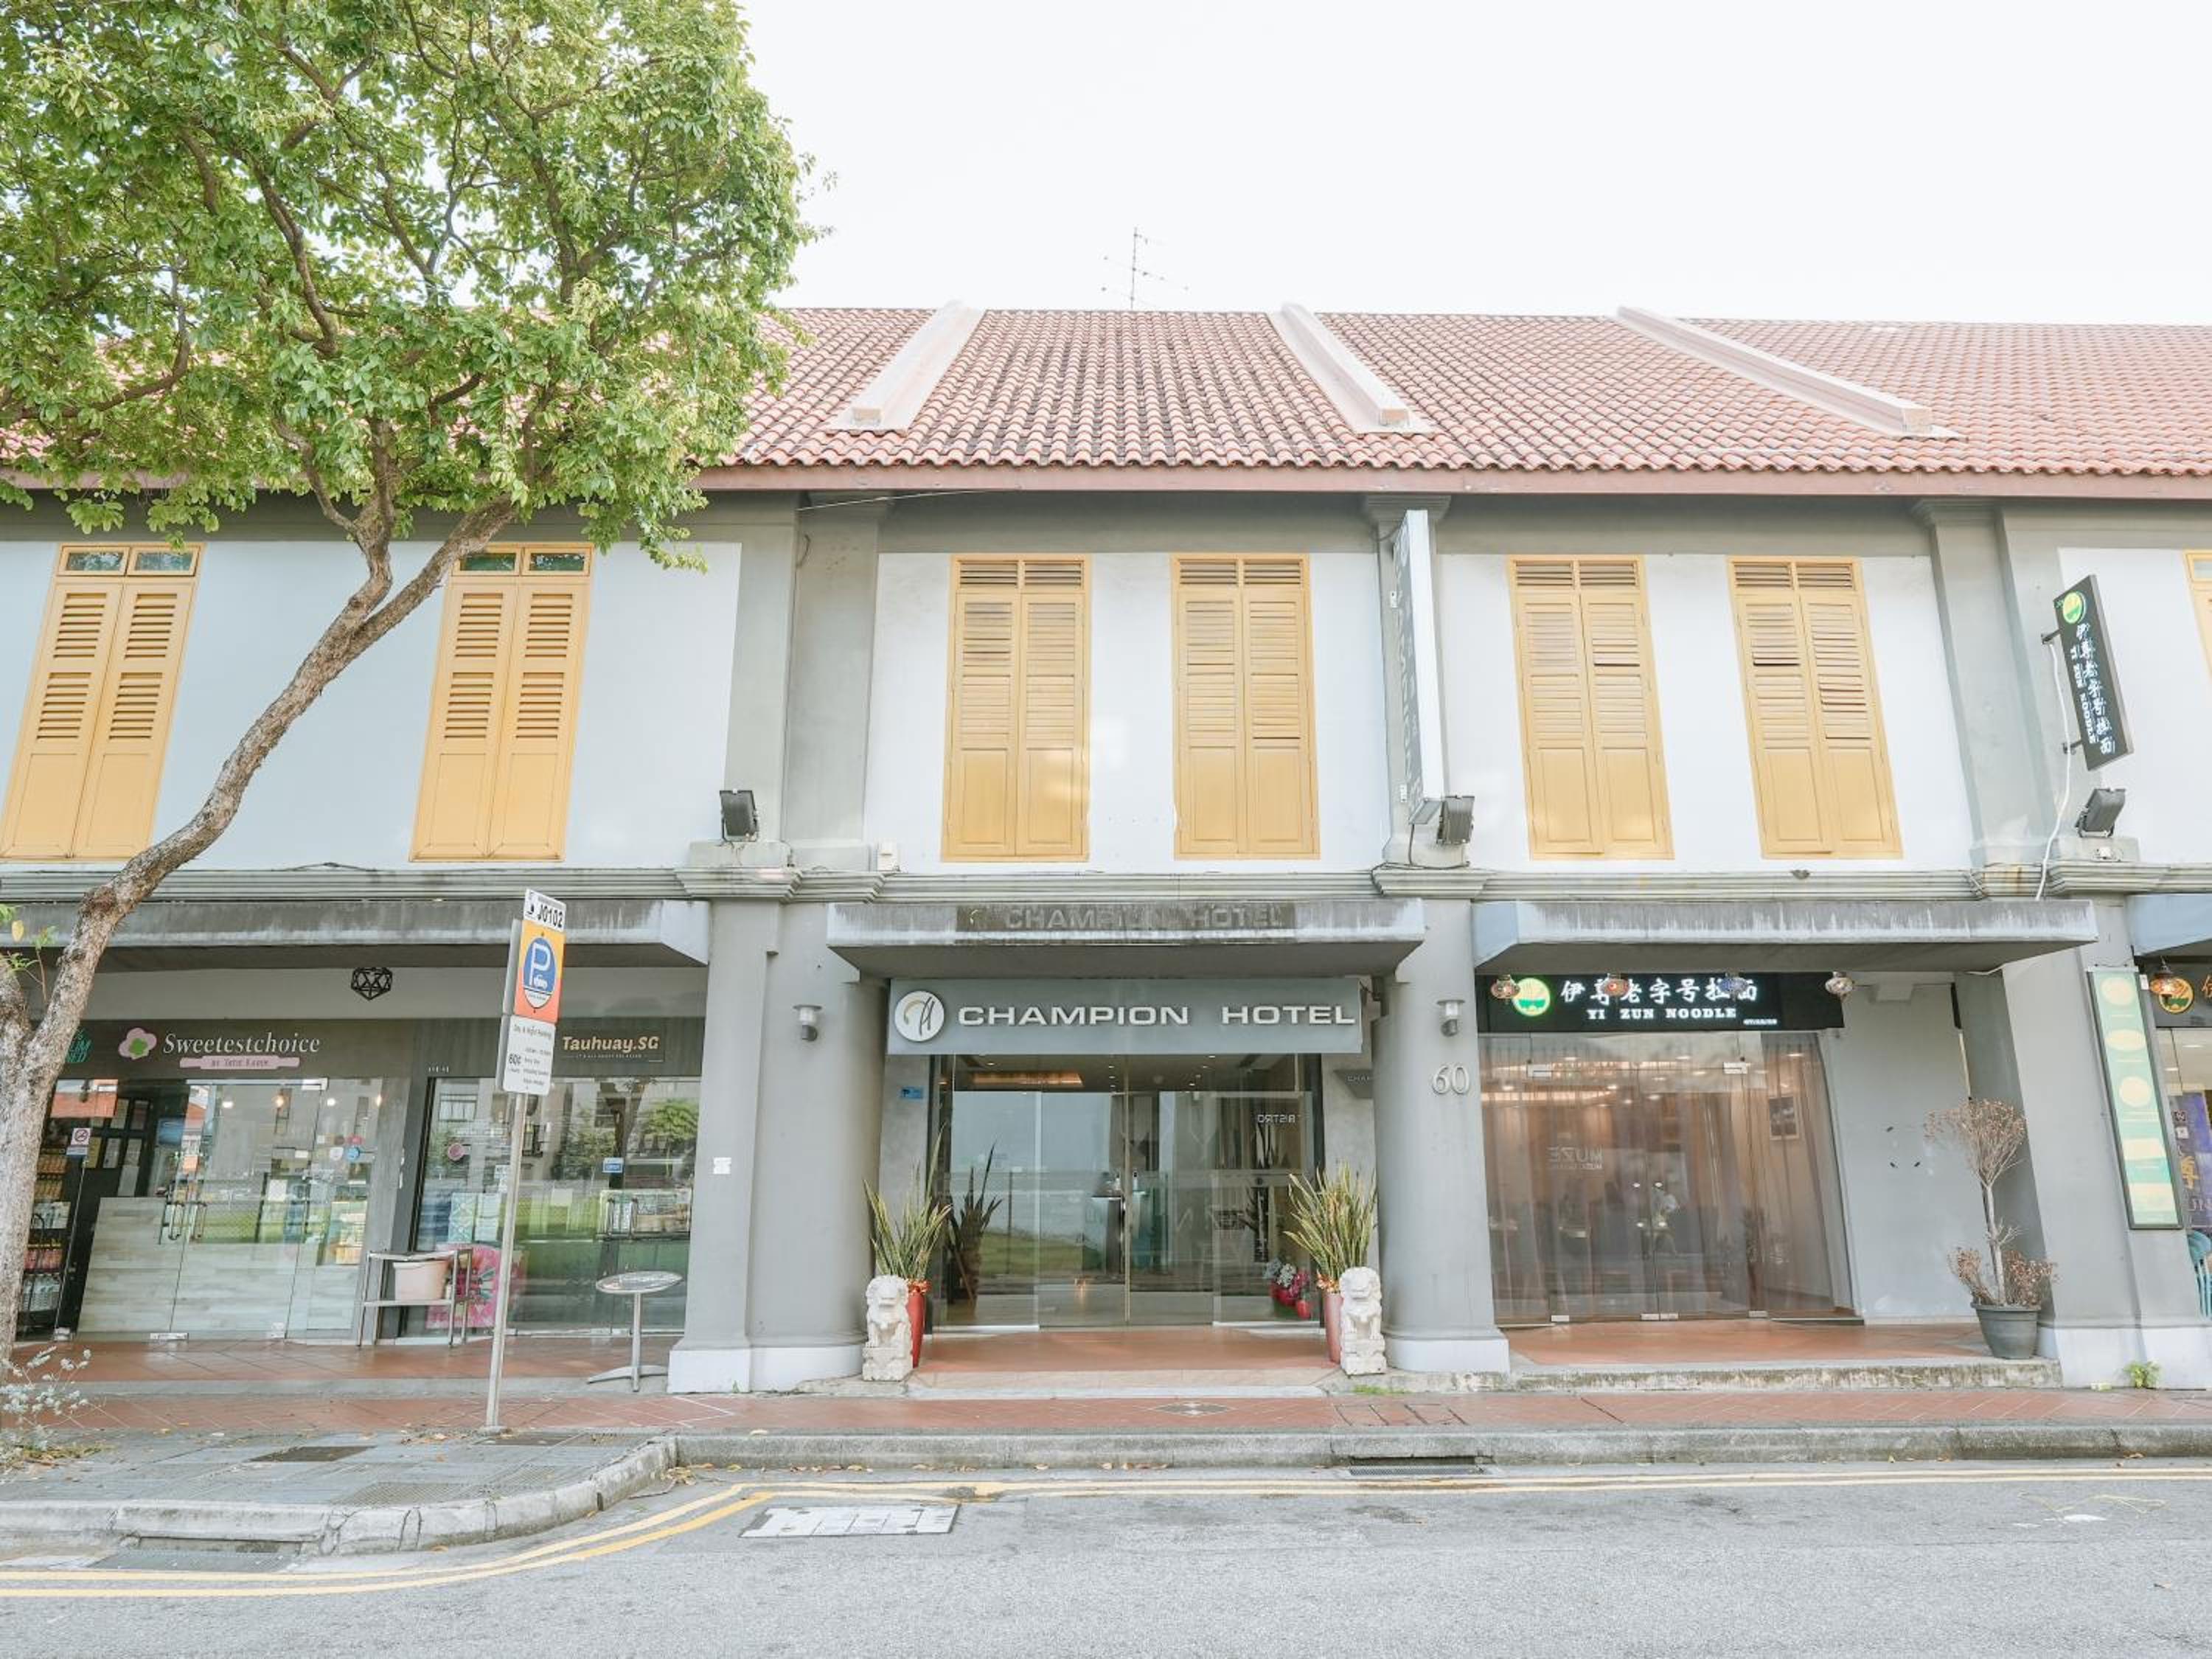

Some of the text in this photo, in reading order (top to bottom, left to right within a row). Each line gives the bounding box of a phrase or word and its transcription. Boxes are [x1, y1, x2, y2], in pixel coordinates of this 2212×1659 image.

[958, 1006, 1356, 1026] CHAMPION HOTEL
[1587, 1008, 1736, 1020] YI ZUN NOODLE
[163, 1032, 320, 1054] Sweetestchoice
[563, 1036, 659, 1053] Tauhuay.SG
[1433, 1065, 1470, 1095] 60
